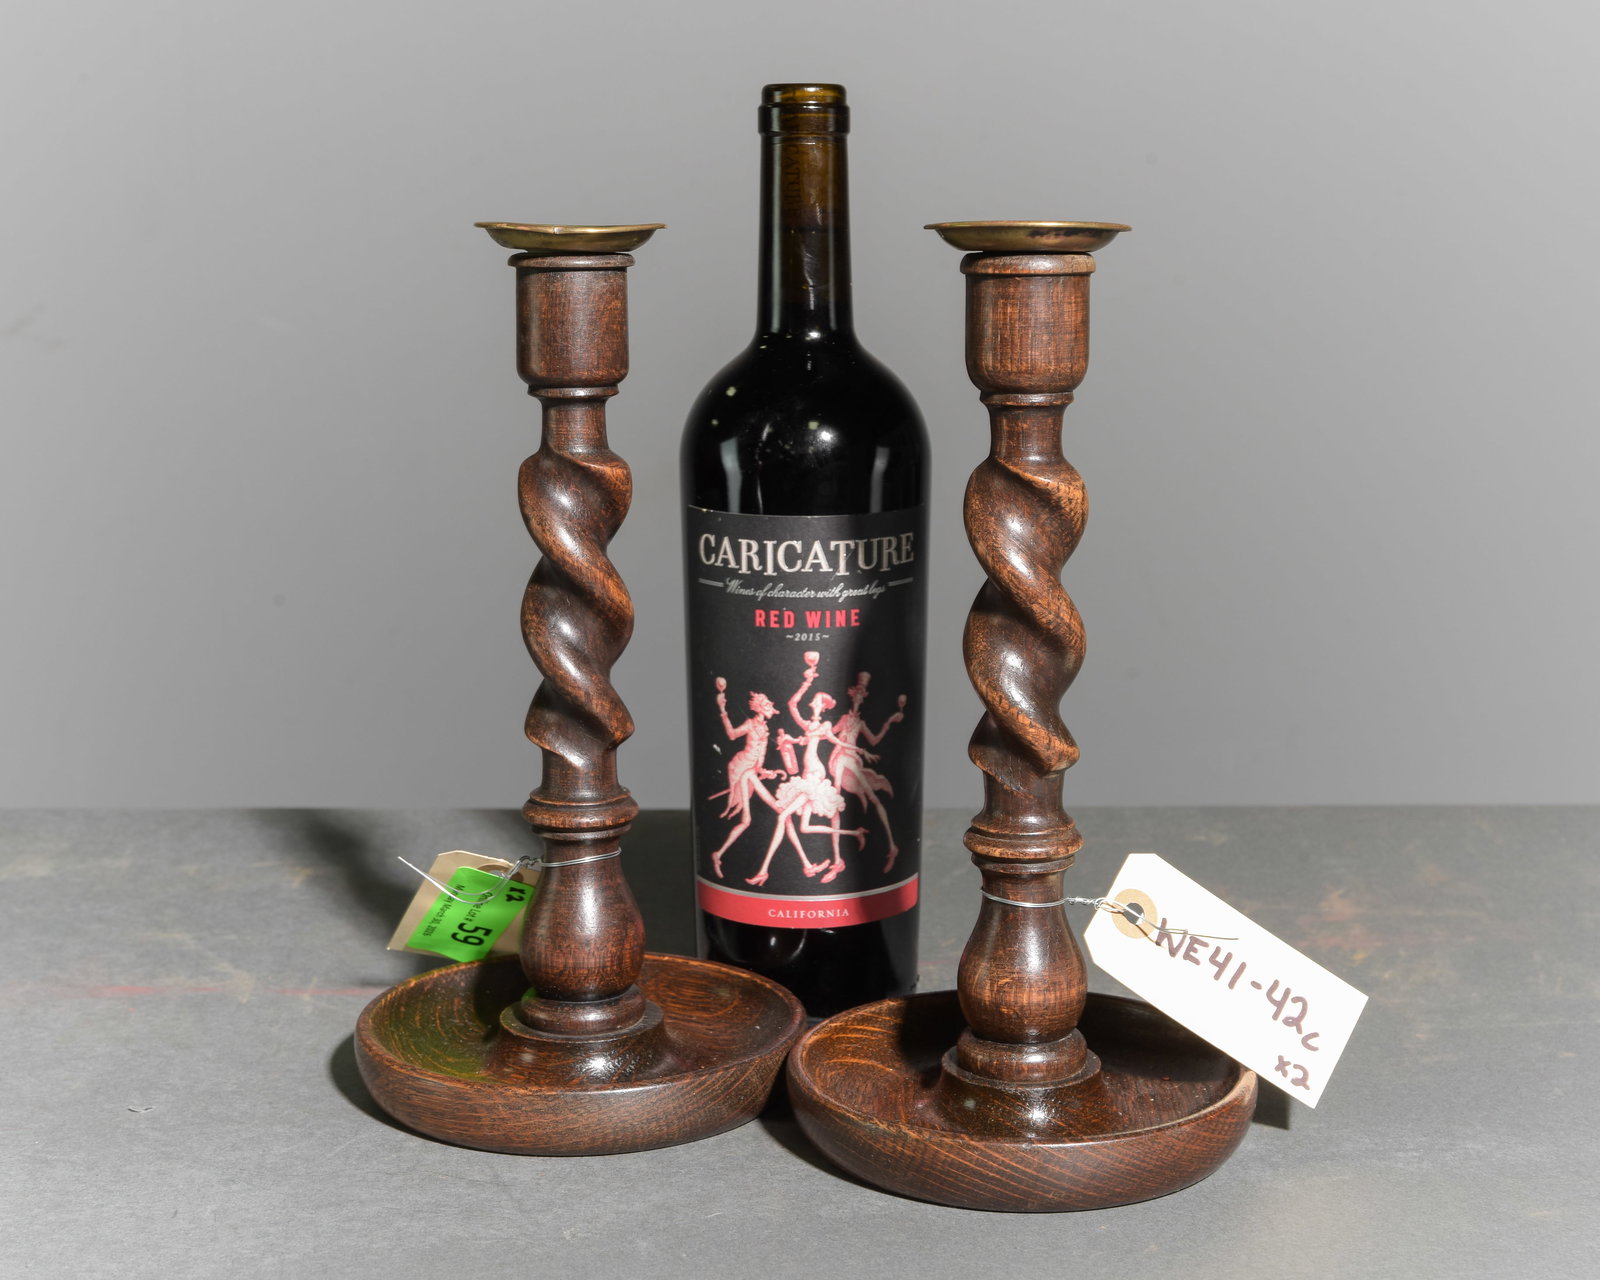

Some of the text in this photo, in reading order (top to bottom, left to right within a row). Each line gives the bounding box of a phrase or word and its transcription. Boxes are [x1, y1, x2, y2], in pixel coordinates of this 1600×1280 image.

[699, 532, 914, 576] CARICATURE
[726, 577, 887, 602] Wines of character with great legs
[755, 608, 861, 629] RED WINE
[768, 908, 850, 919] CALIFORNIA
[451, 922, 493, 946] 59
